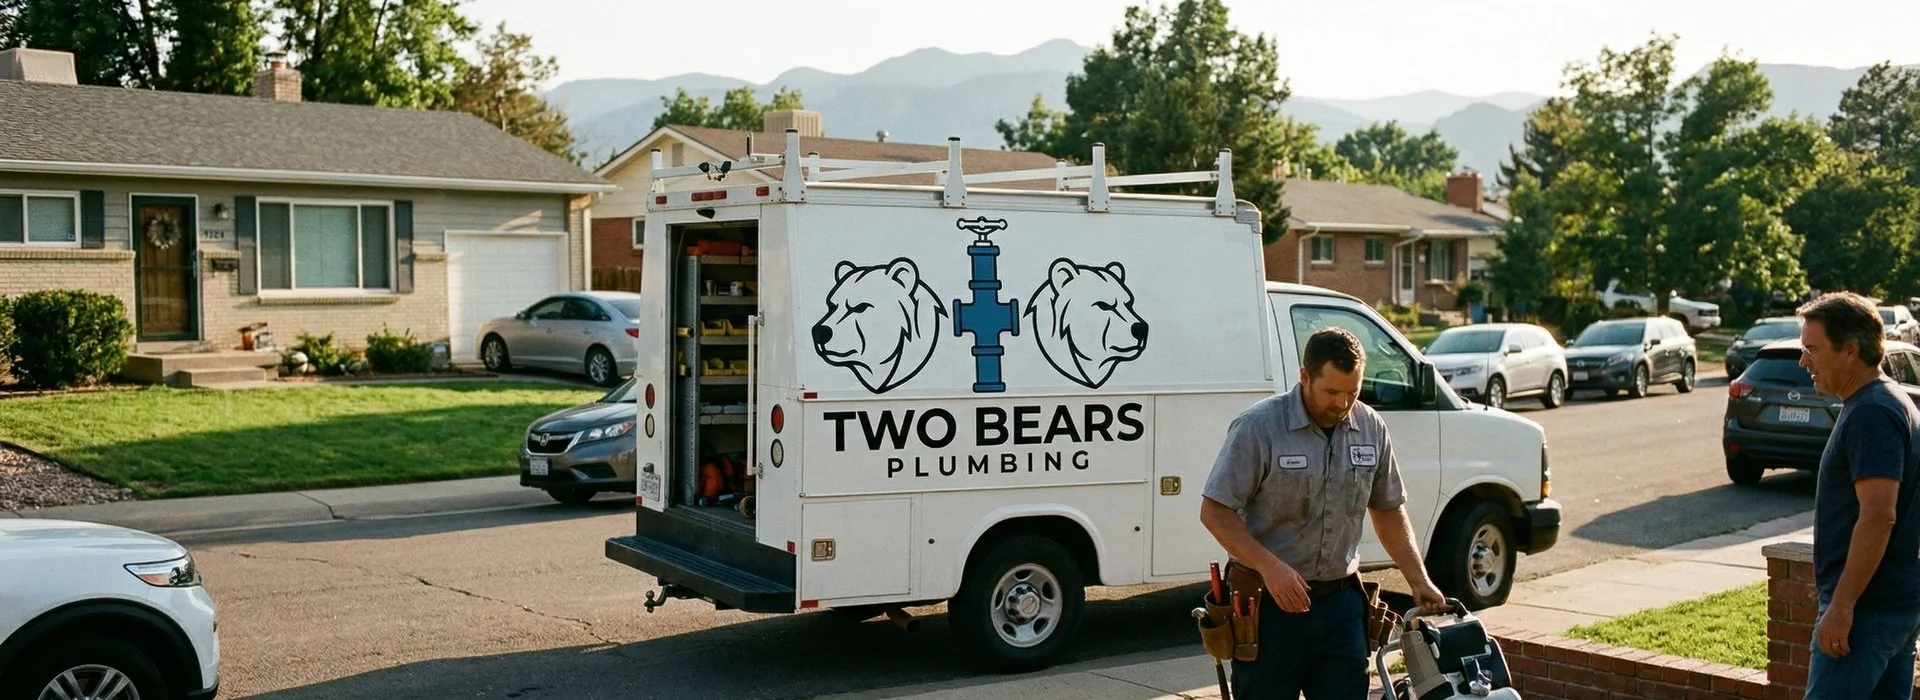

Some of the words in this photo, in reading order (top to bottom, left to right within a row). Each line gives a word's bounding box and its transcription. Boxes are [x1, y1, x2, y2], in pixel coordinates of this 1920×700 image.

[823, 407, 957, 452] TWO
[975, 402, 1145, 447] BEARS
[887, 450, 1090, 478] PLUMBING
